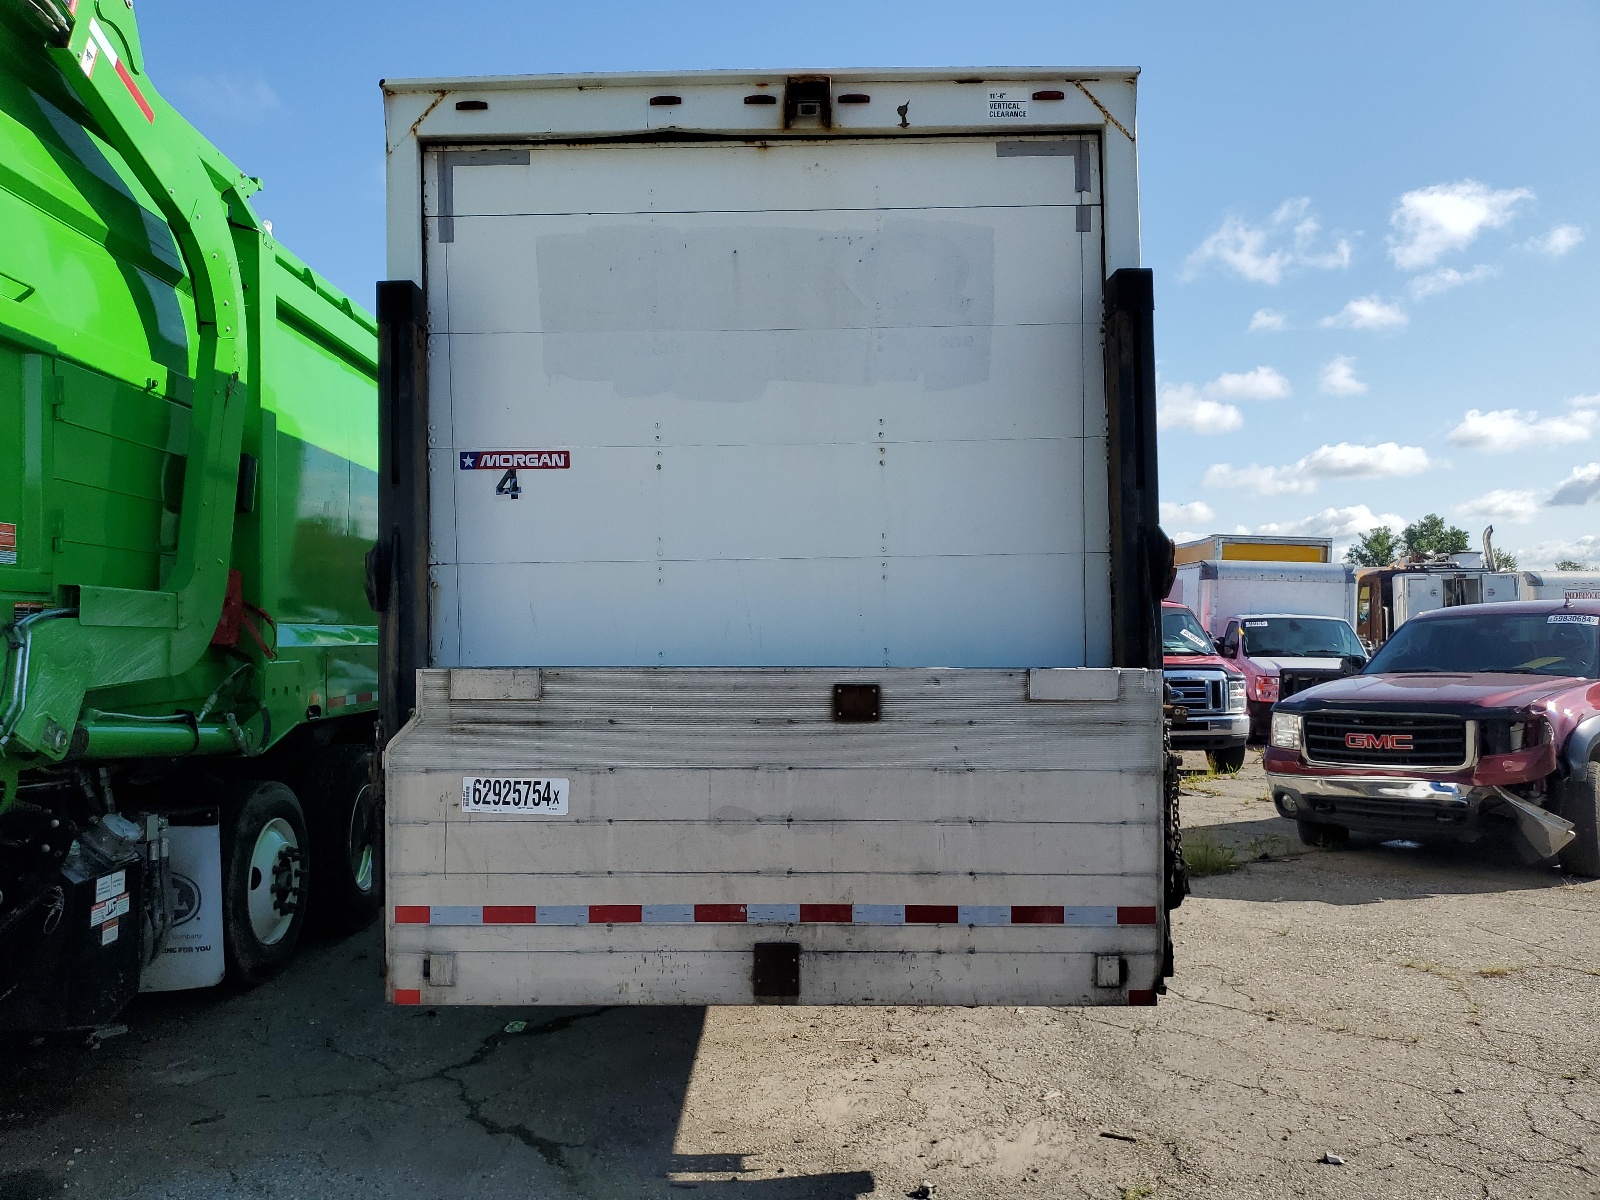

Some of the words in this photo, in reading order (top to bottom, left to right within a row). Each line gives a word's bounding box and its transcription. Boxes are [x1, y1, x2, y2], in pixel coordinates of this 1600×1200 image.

[480, 454, 565, 467] MORGAN
[496, 469, 521, 499] 4
[1345, 733, 1413, 749] GMC
